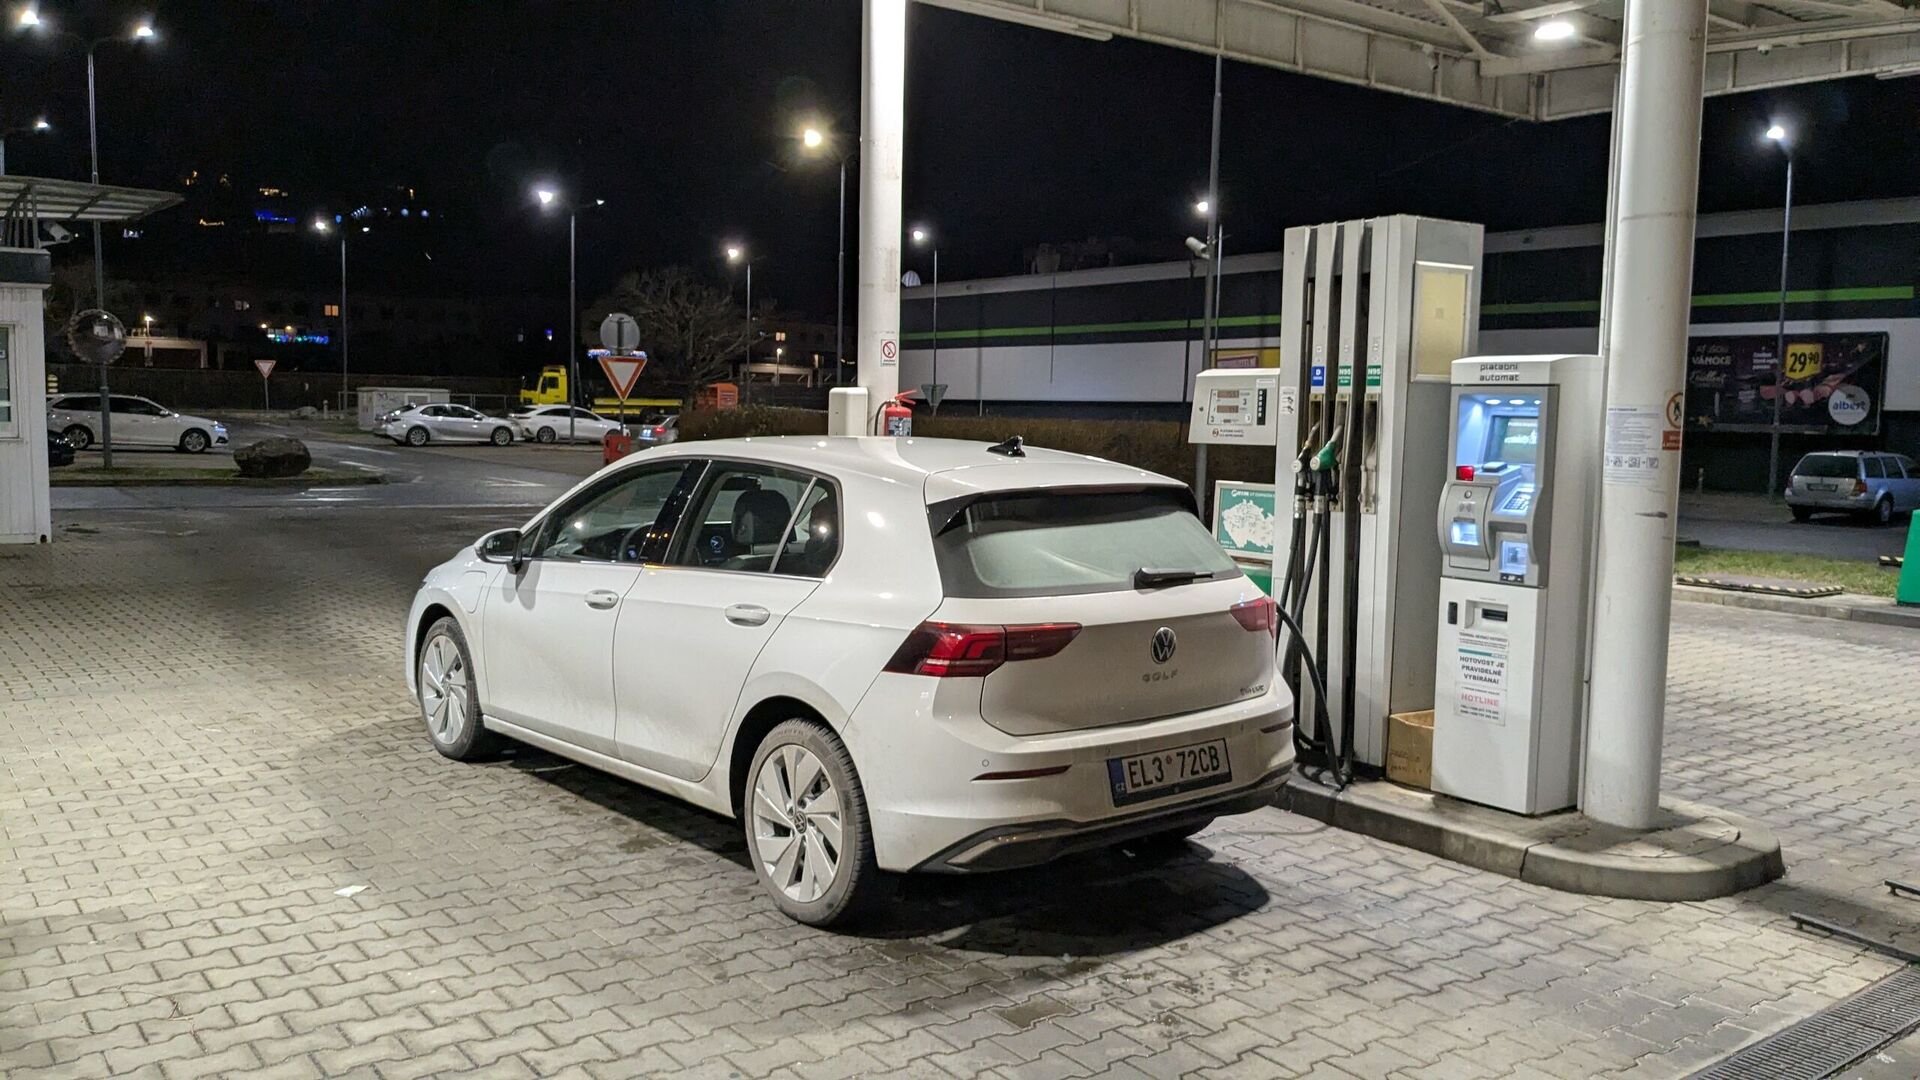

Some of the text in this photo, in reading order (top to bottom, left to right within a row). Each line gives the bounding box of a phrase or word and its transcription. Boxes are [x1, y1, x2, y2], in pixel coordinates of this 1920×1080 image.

[1480, 374, 1519, 382] automat
[1459, 655, 1495, 666] HOTOVOST
[1141, 669, 1178, 683] GOLF
[1461, 664, 1502, 676] PRAVIDELNĚ
[1461, 693, 1500, 706] HOTLINE
[1127, 745, 1220, 789] EL3 72CB
